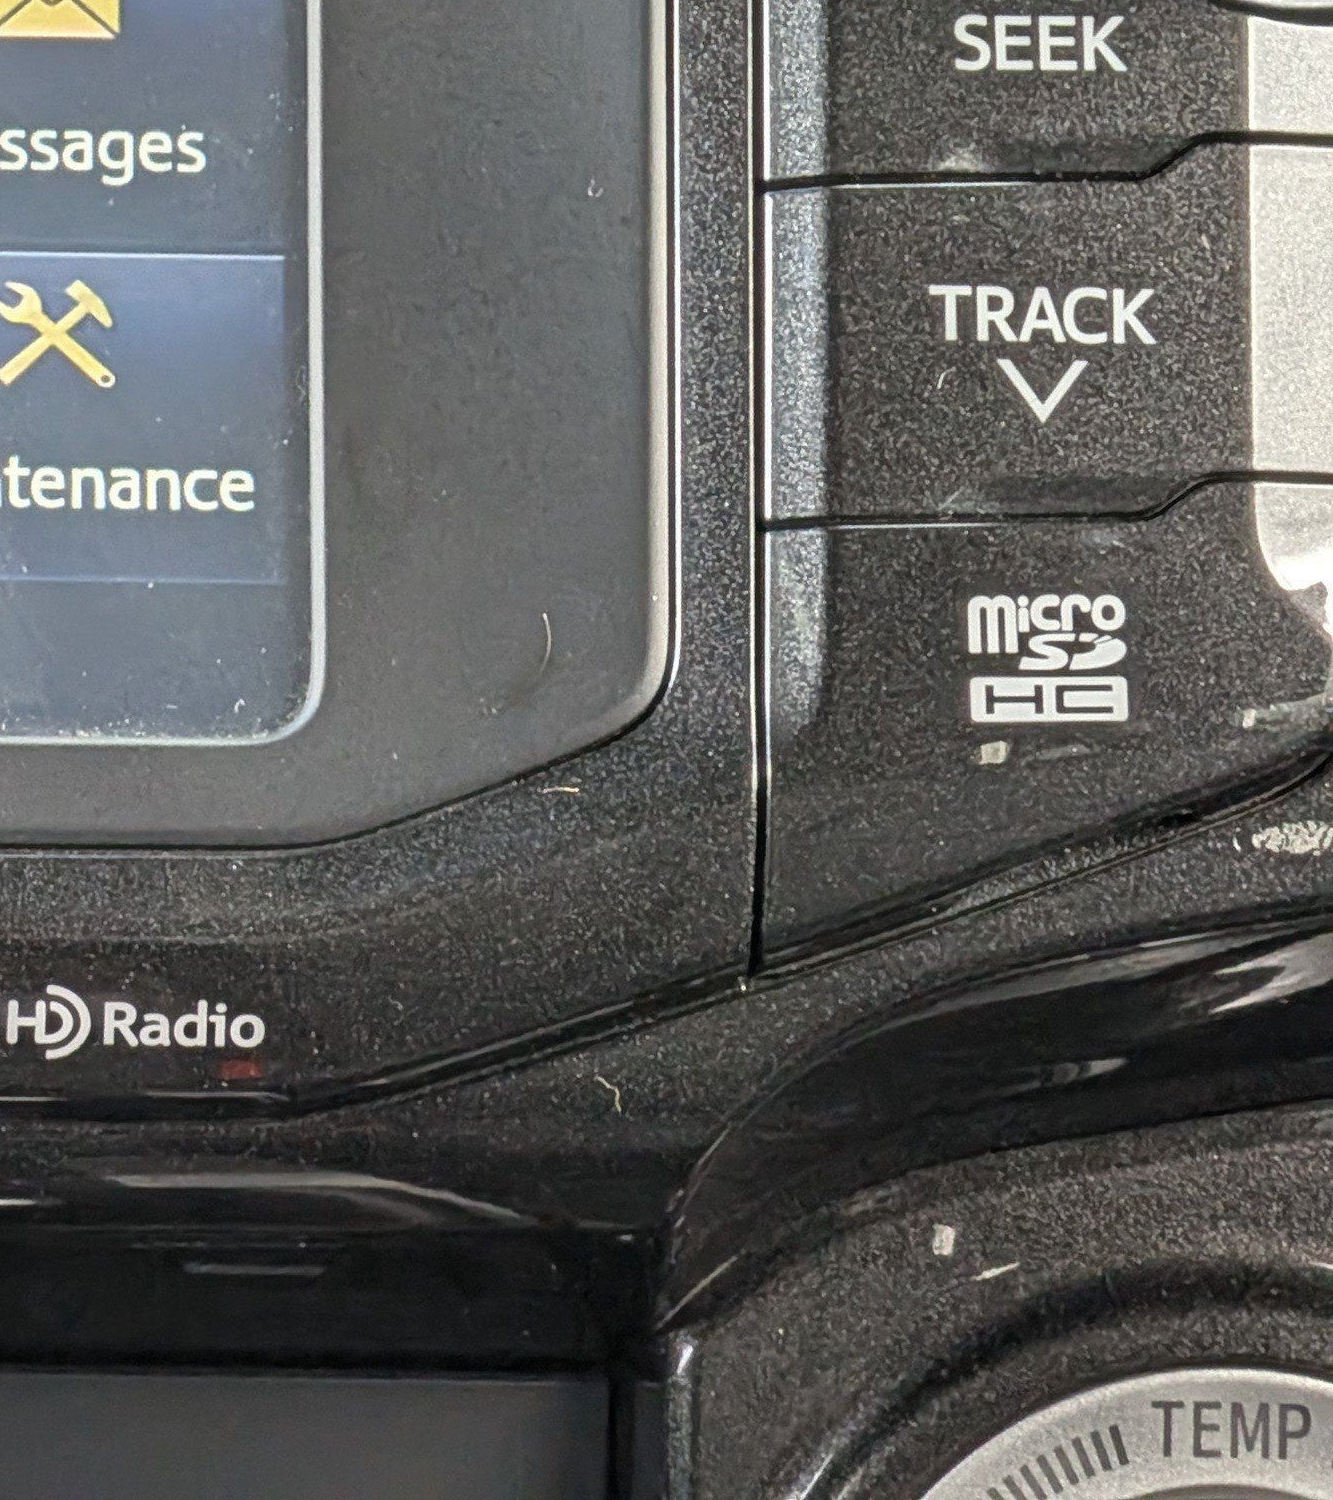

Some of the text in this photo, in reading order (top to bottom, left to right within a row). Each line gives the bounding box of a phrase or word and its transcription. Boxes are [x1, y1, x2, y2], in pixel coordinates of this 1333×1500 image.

[953, 13, 1128, 72] SEEK
[927, 284, 1158, 345] TRACK
[984, 683, 1115, 715] HC
[5, 985, 266, 1059] HD Radio
[1150, 1400, 1313, 1460] TEMP
